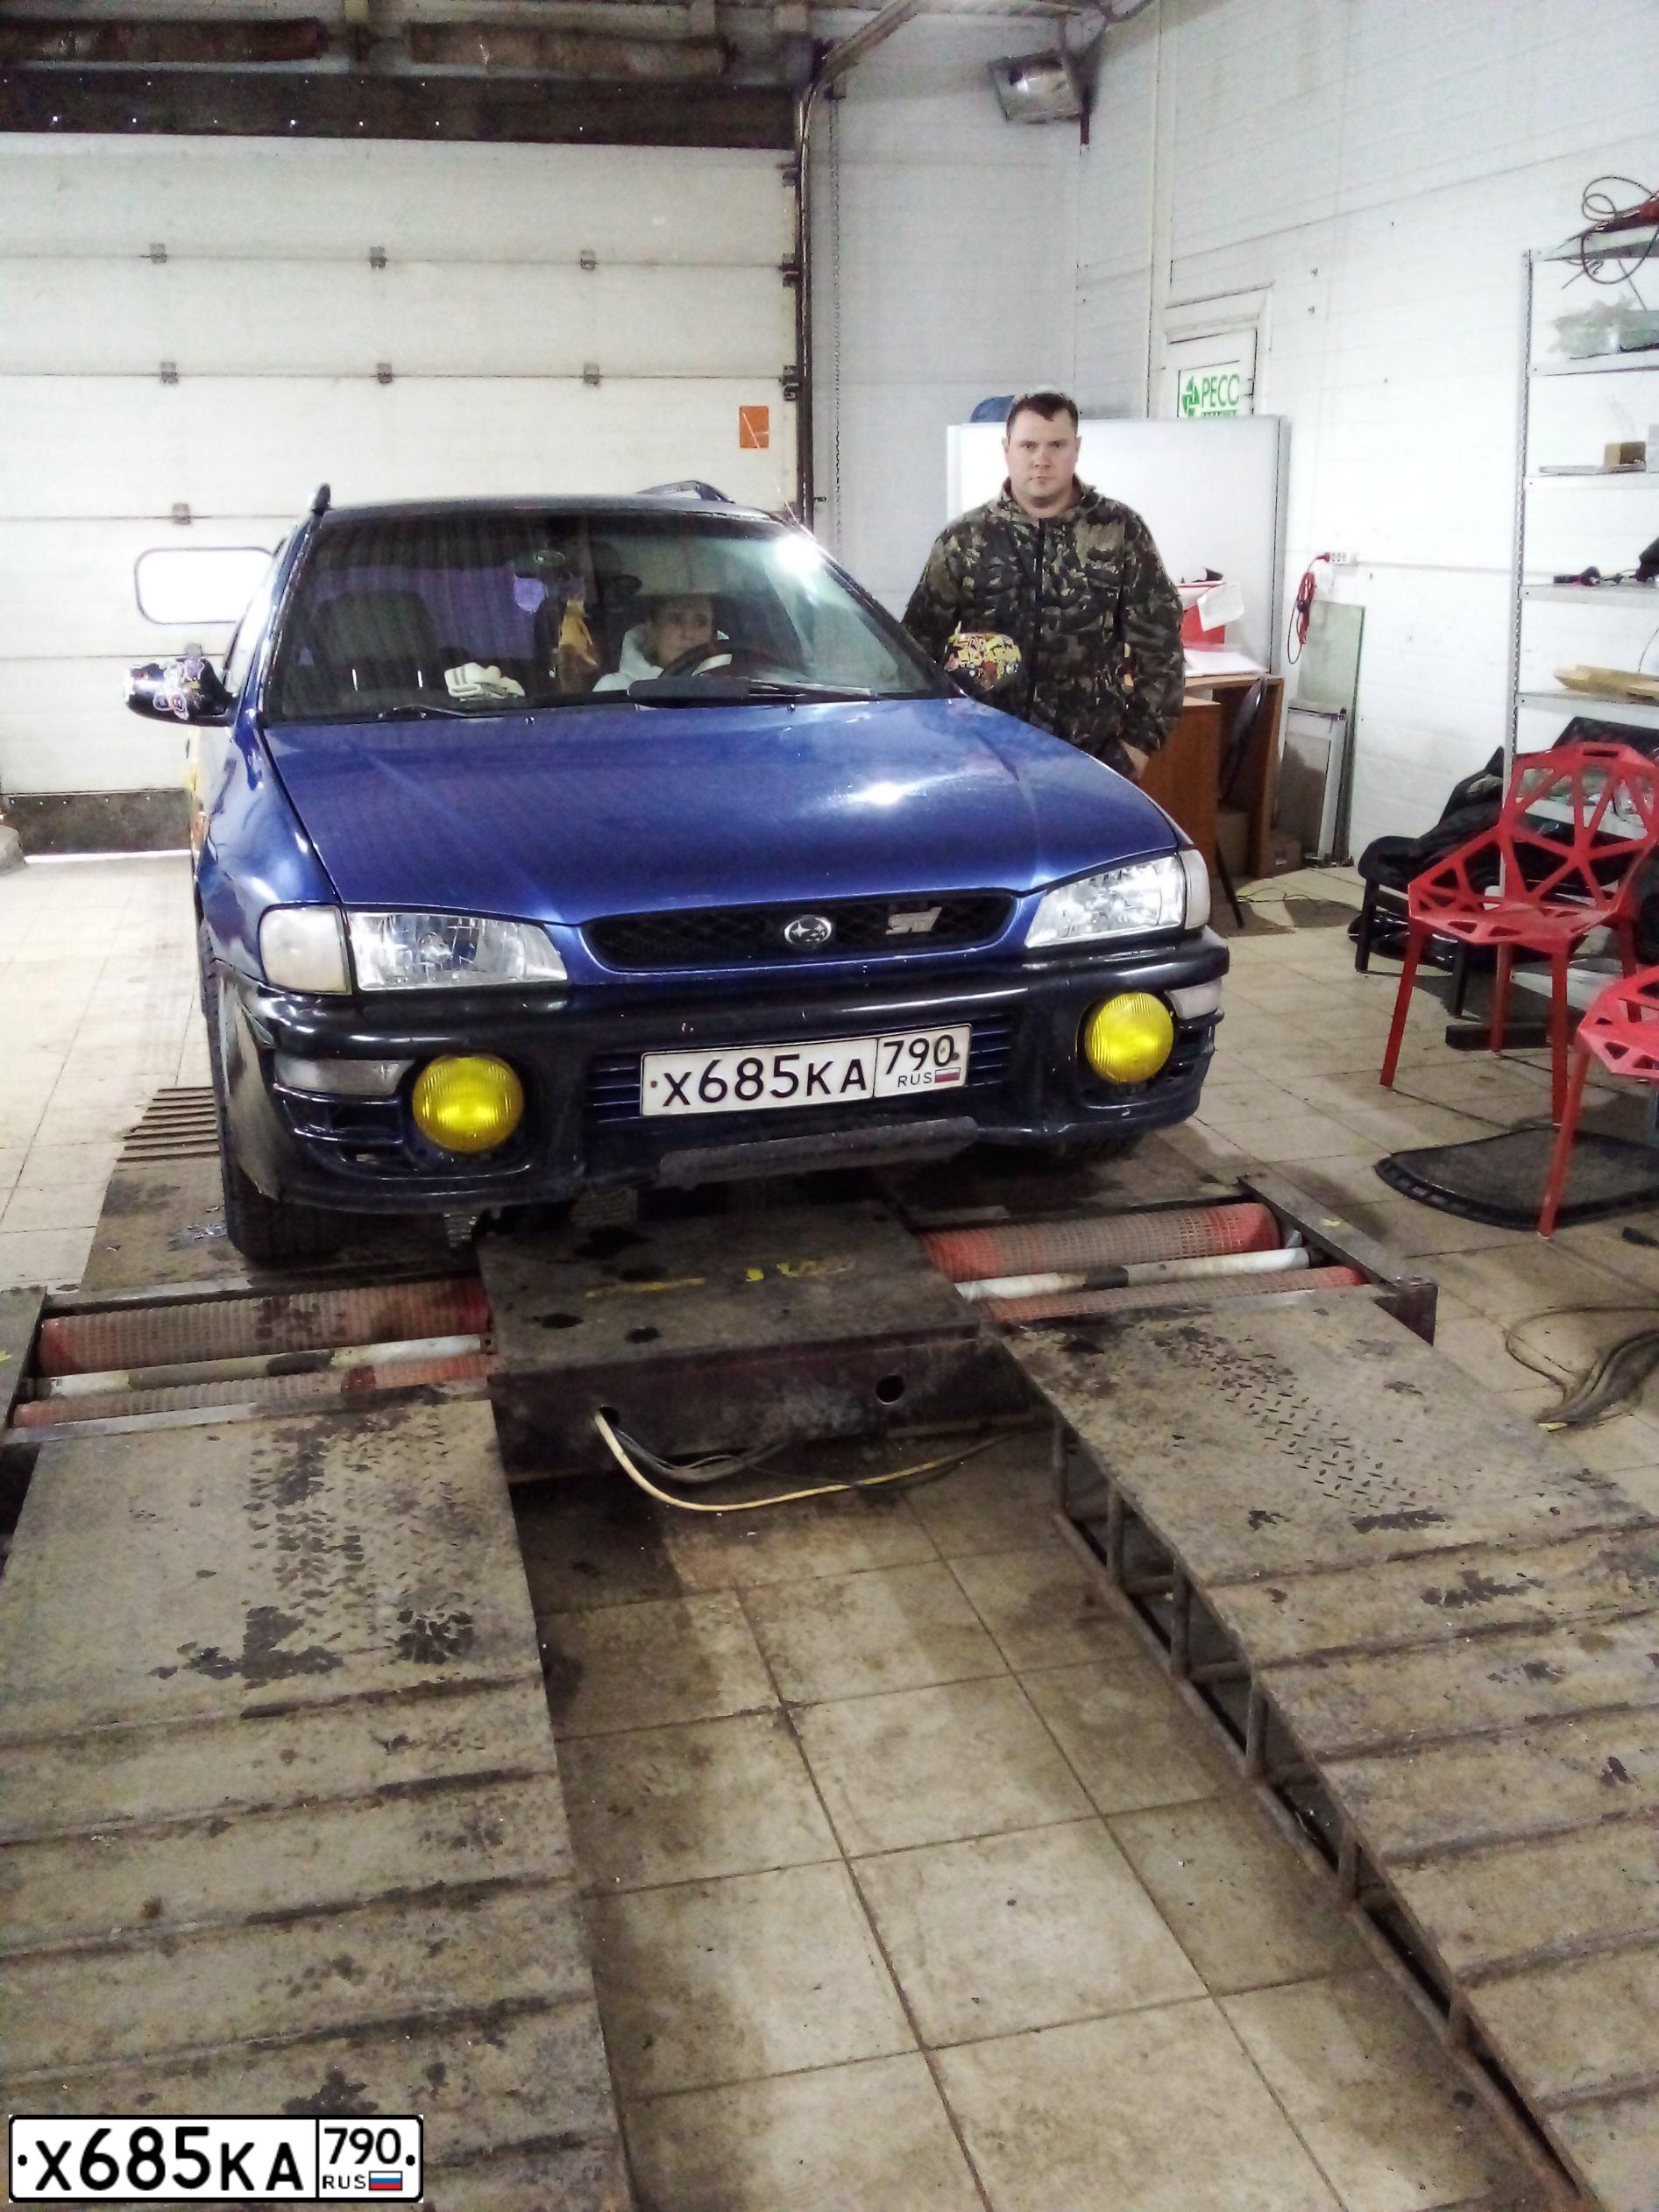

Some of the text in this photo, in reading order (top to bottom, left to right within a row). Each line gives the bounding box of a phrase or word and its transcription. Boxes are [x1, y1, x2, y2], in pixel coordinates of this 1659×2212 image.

[663, 1034, 954, 1107] Х685КА 790
[897, 1073, 932, 1088] RUS
